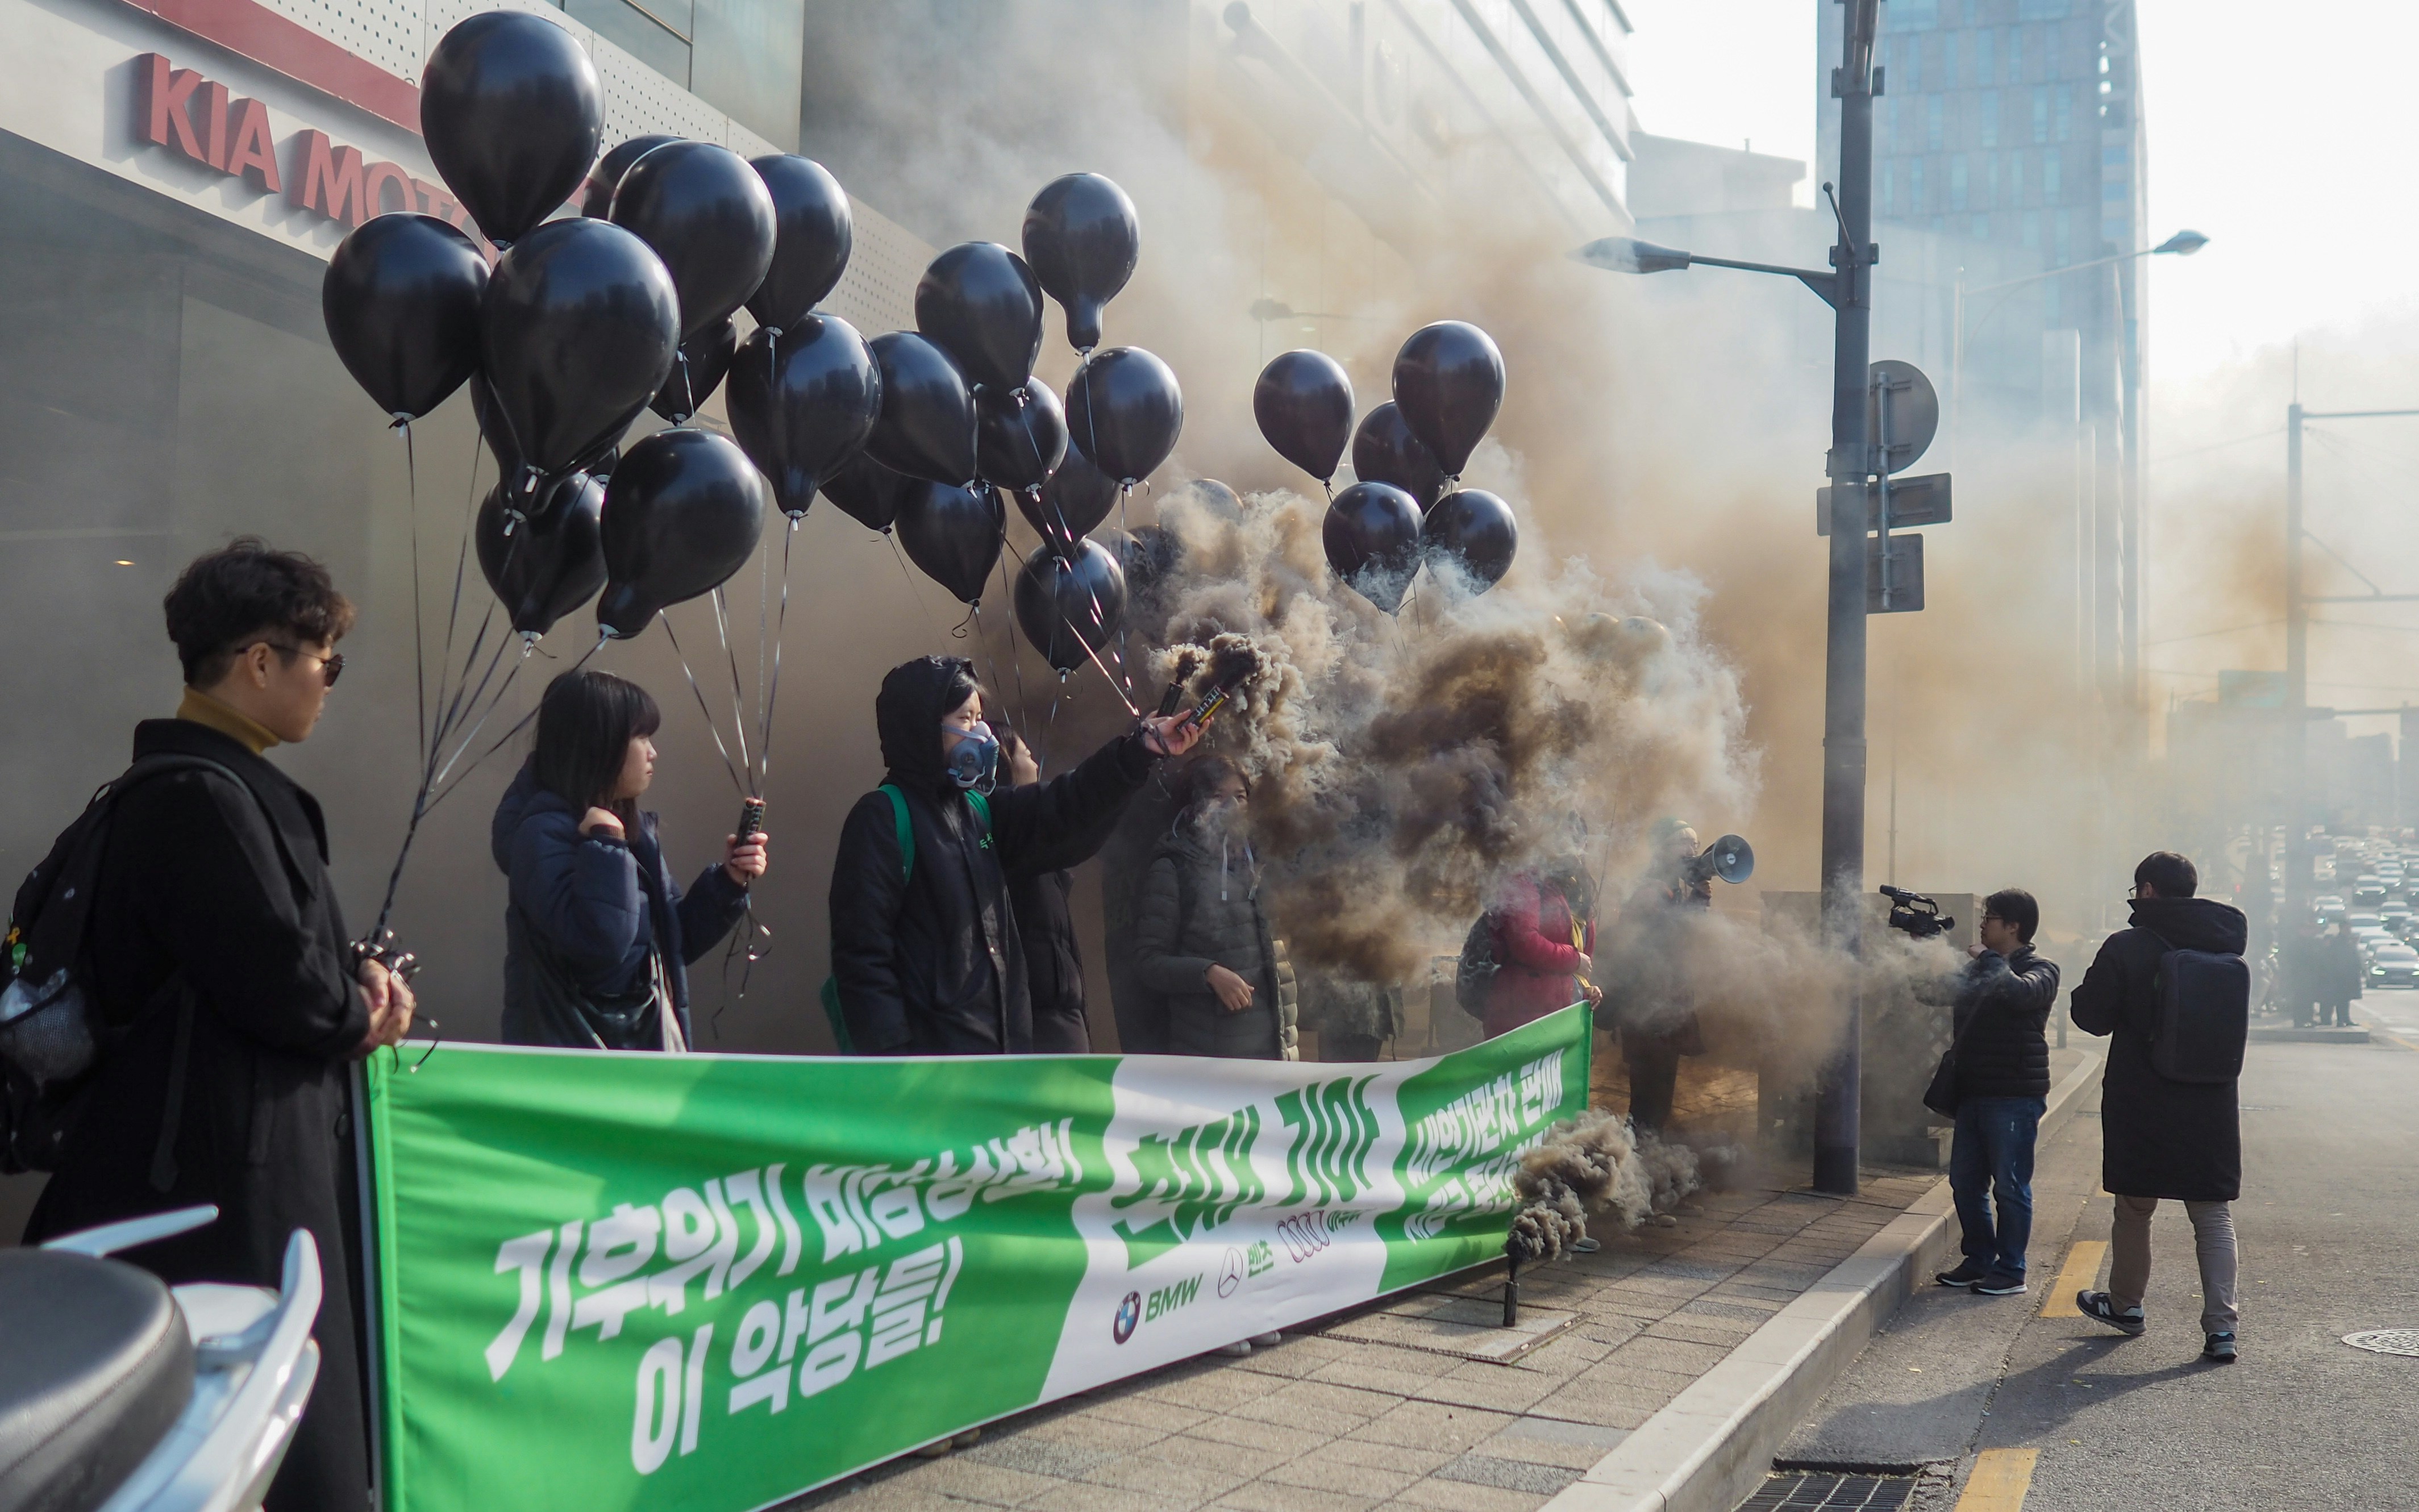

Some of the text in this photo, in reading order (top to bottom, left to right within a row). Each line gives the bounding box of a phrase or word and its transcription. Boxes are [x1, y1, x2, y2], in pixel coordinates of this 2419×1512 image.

[138, 52, 281, 193] KIA
[1111, 1073, 1383, 1271] 현대 기아
[1406, 1048, 1565, 1189] 내연기관차 판매
[485, 1163, 801, 1382] 기후위기
[1144, 1272, 1204, 1324] BMW
[1247, 1239, 1274, 1278] 벤츠
[2098, 1301, 2111, 1315] N
[631, 1236, 963, 1476] 이 악당들!
